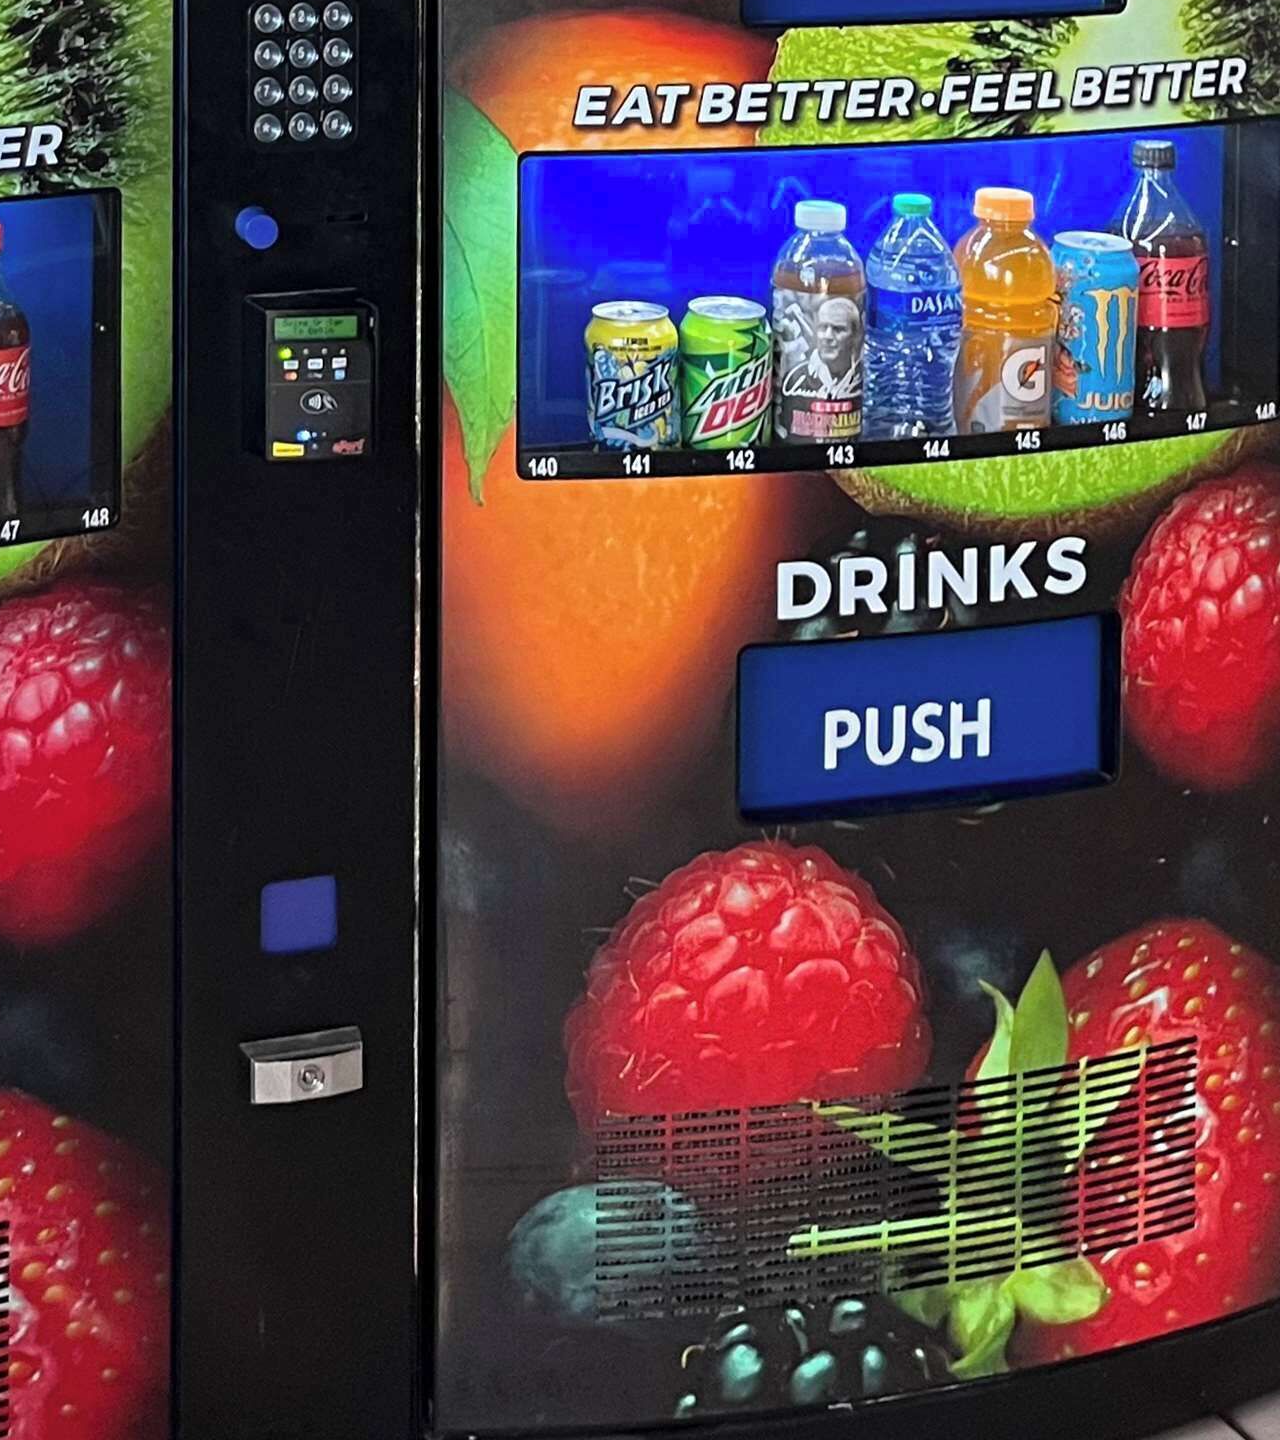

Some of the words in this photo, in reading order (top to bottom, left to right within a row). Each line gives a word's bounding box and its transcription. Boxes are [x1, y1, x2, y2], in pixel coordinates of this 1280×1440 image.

[572, 84, 692, 126] EAT
[697, 77, 913, 124] BETTER
[937, 68, 1063, 114] FEEL
[1070, 57, 1247, 106] BETTER
[1001, 345, 1046, 403] G
[633, 400, 656, 421] ICED
[1102, 422, 1127, 441] 146
[1186, 412, 1207, 431] 147
[923, 439, 950, 459] 144
[1015, 431, 1041, 450] 145
[622, 454, 651, 475] 141
[726, 450, 755, 470] 142
[826, 445, 855, 465] 143
[528, 458, 558, 478] 140
[82, 507, 110, 529] 148
[776, 537, 1087, 621] DRINKS
[824, 698, 991, 770] PUSH
